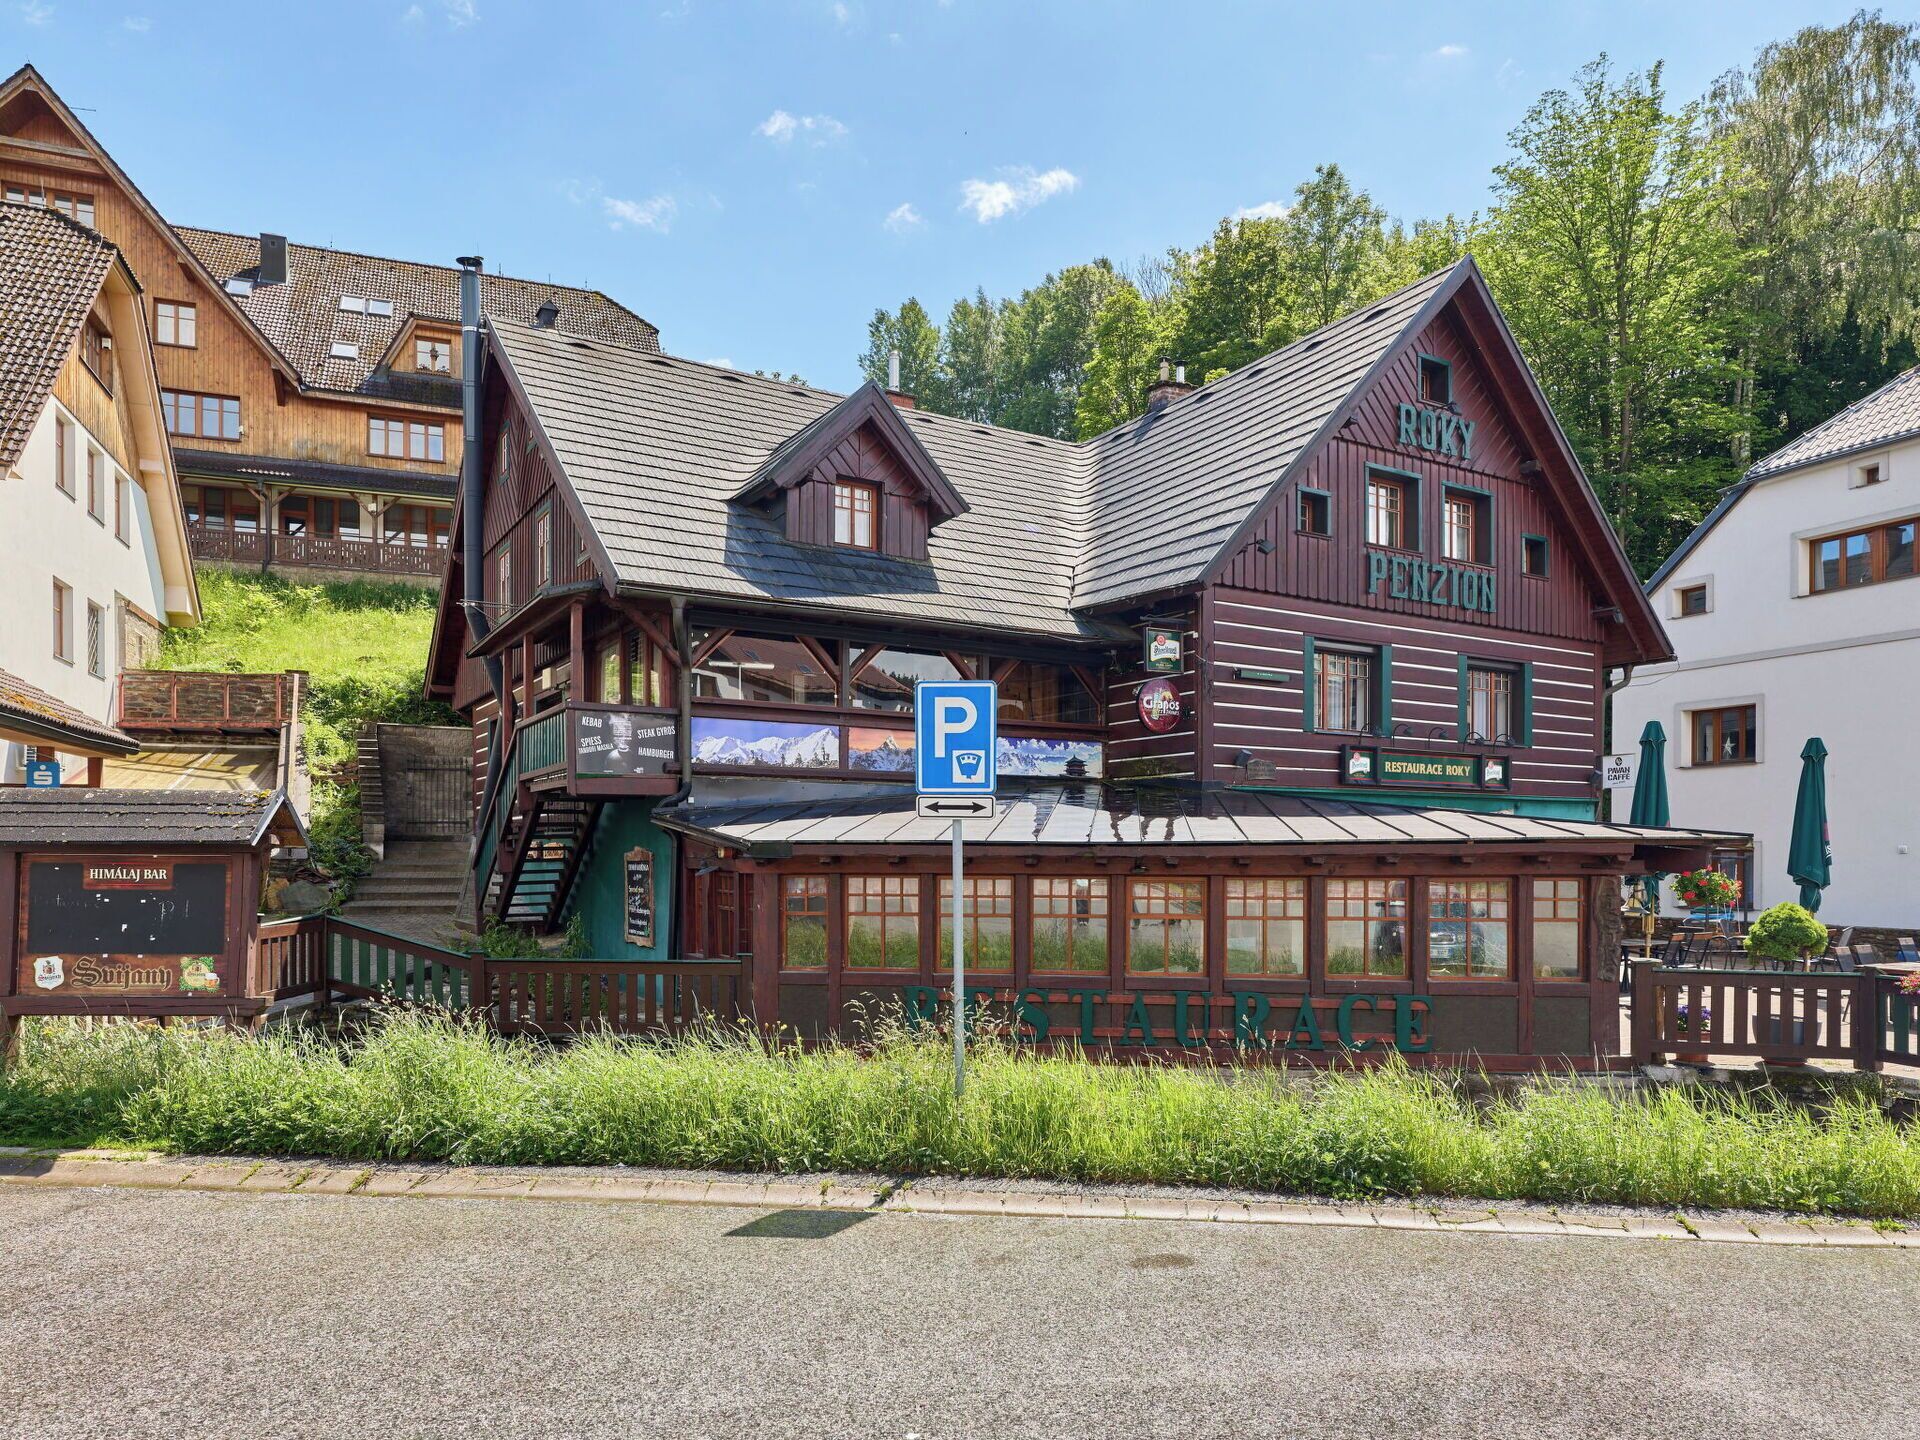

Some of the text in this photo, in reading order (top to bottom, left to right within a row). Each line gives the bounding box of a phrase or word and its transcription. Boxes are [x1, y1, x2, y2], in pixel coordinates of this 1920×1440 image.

[1398, 402, 1475, 460] ROKY
[1366, 551, 1497, 613] PENZION
[581, 716, 602, 728] KEBAB
[934, 696, 978, 758] P
[637, 725, 676, 739] STEAK GYROS
[581, 736, 602, 747] SPIESS
[638, 747, 674, 759] HAMBURGER
[1385, 761, 1443, 775] RESTAURACE
[1446, 765, 1471, 777] ROKY
[89, 866, 168, 882] HIMÁLAJ BAR
[71, 956, 172, 991] Svijany
